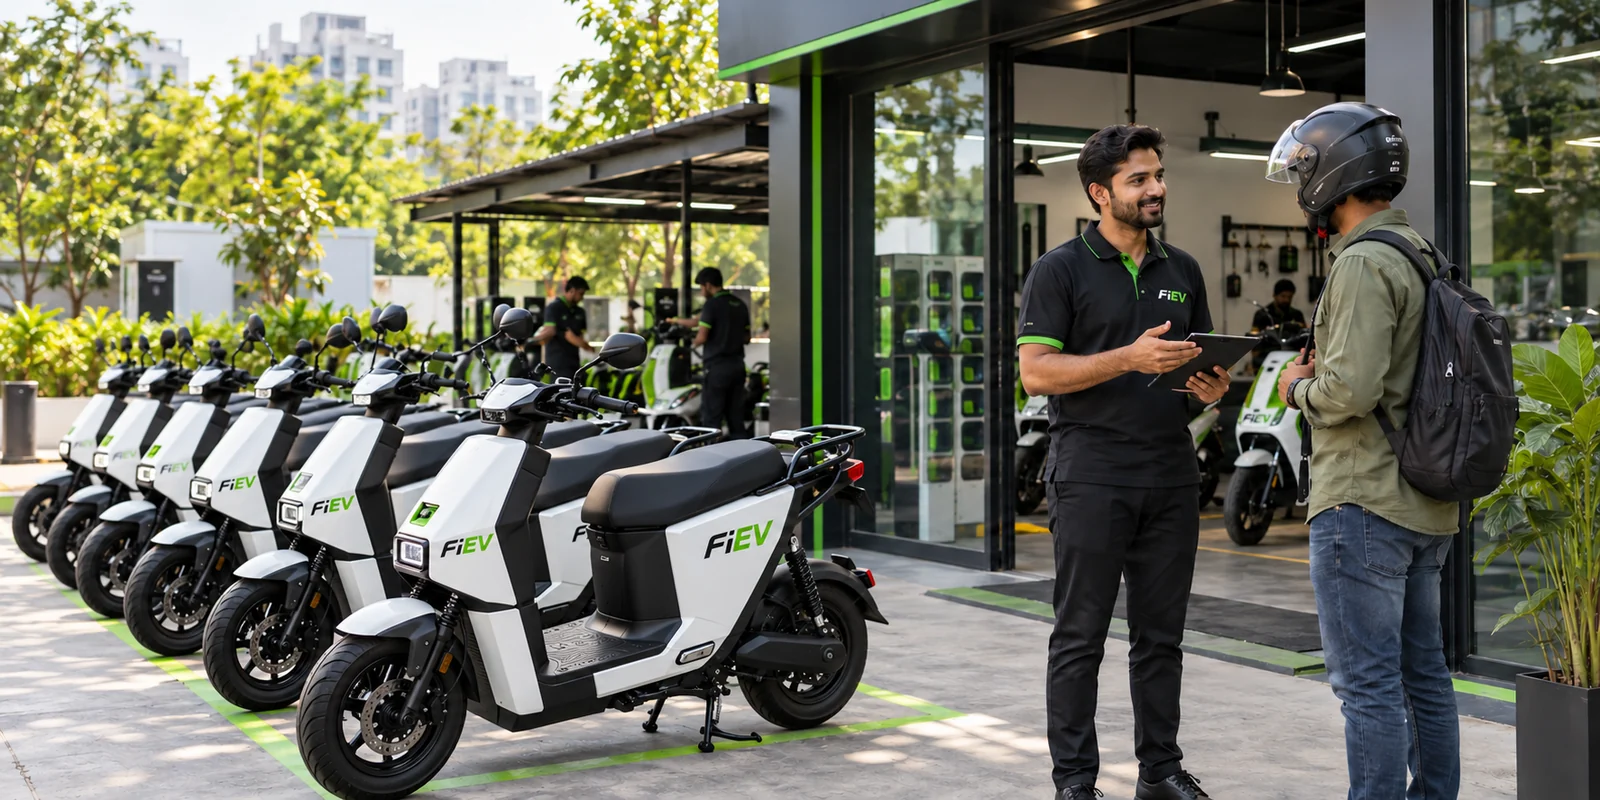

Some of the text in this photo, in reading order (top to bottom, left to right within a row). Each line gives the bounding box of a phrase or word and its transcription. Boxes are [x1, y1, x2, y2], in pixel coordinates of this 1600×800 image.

[1158, 289, 1187, 303] FiEV
[1243, 413, 1271, 424] FiEV
[112, 450, 137, 461] FiEV
[160, 462, 189, 474] FiEV
[218, 475, 256, 492] FiEV
[310, 495, 355, 516] FiEV
[440, 533, 494, 558] FiEV
[704, 519, 774, 559] FiEV
